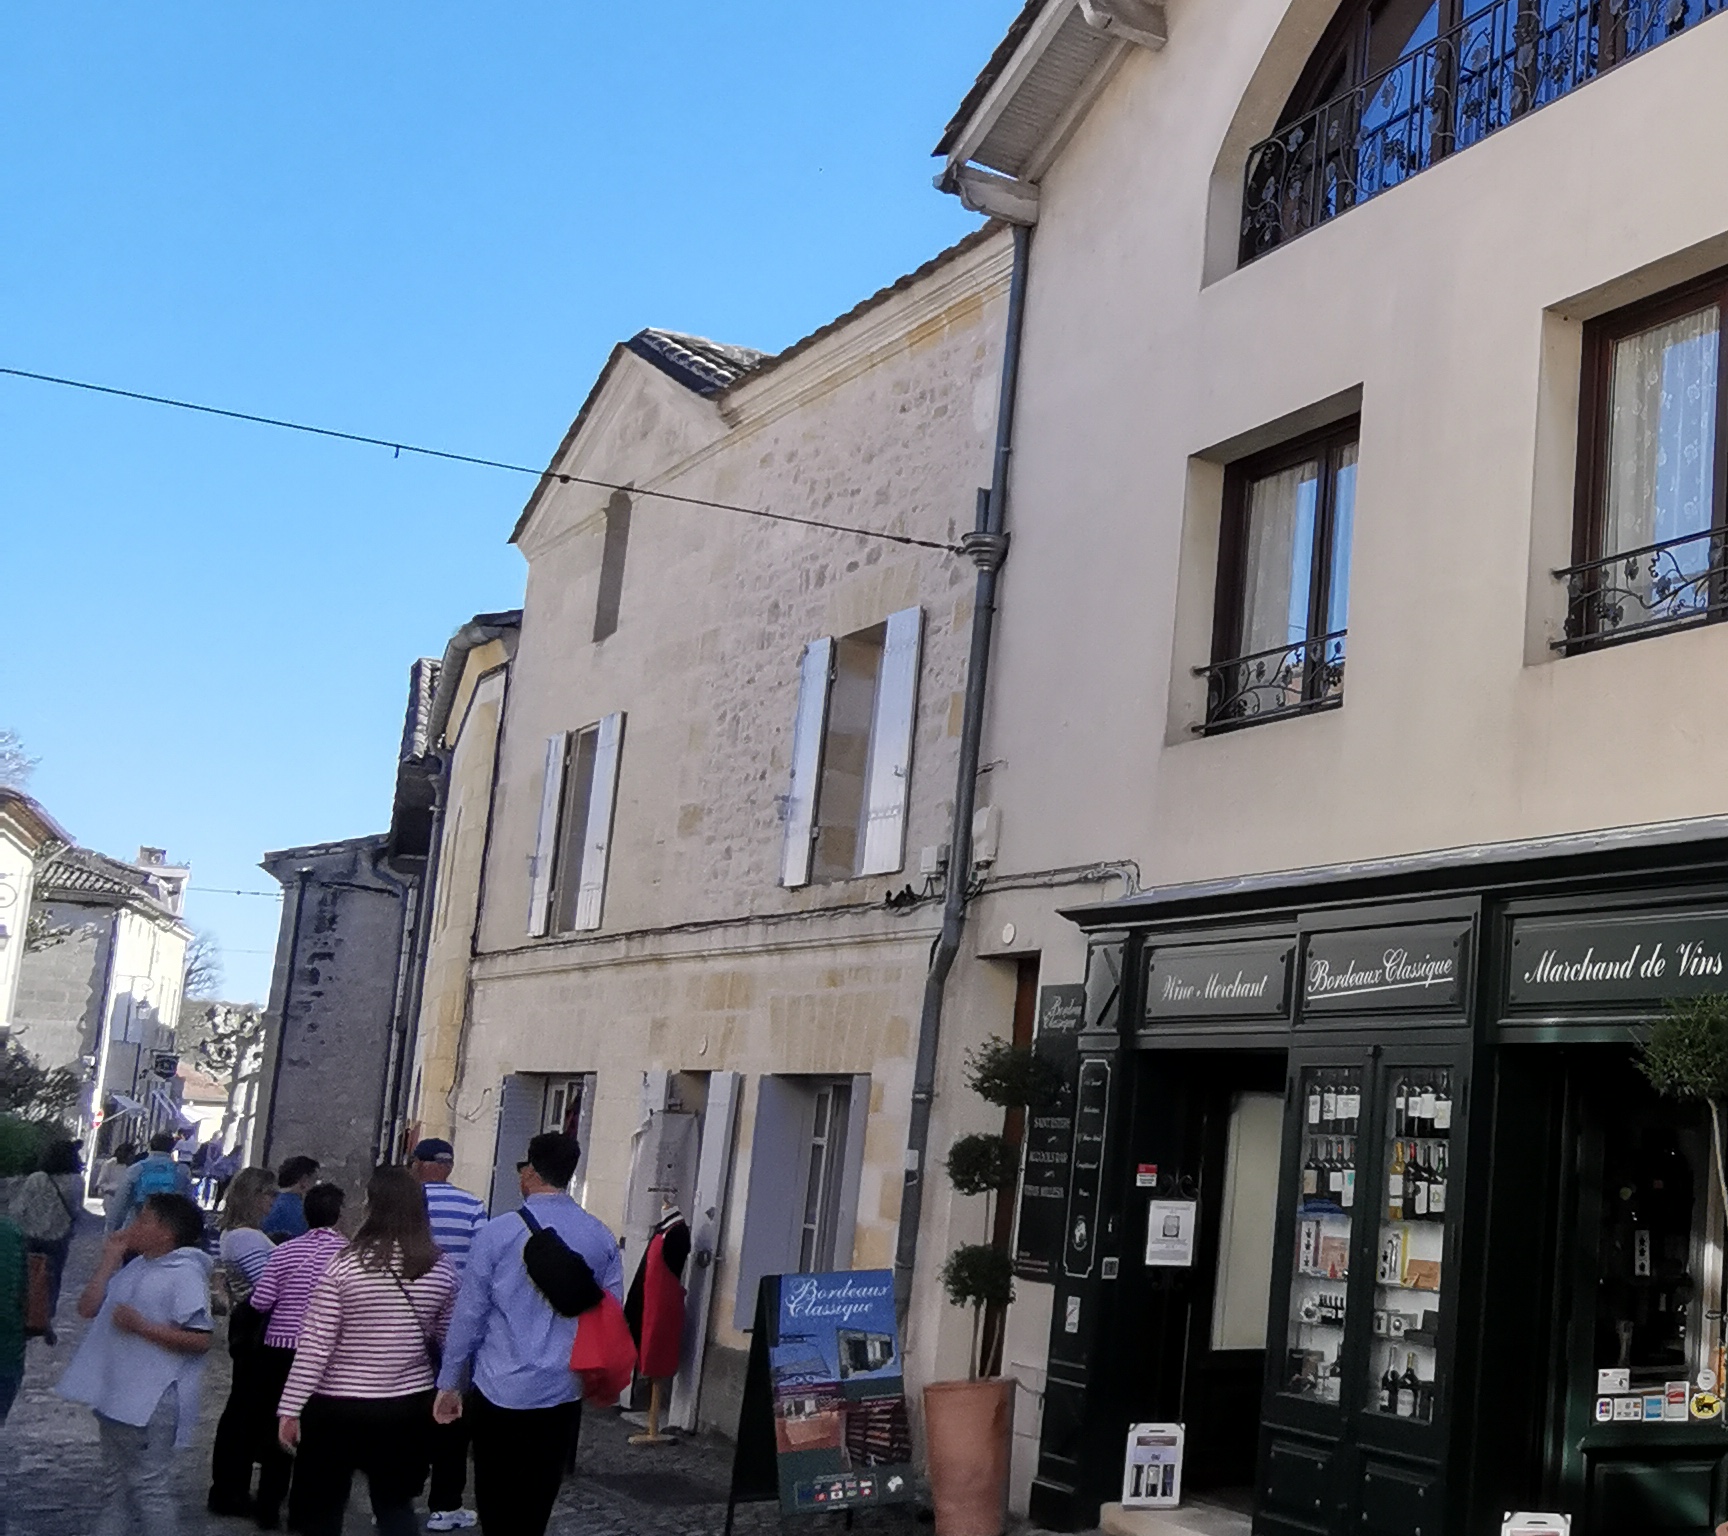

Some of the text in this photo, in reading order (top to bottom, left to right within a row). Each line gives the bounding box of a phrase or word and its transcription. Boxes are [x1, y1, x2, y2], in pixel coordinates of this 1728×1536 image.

[1308, 947, 1453, 993] Bordeaux Classique
[1523, 939, 1724, 984] Marchand de Vins
[784, 1293, 874, 1322] Classique
[786, 1278, 891, 1302] Bordeaux
